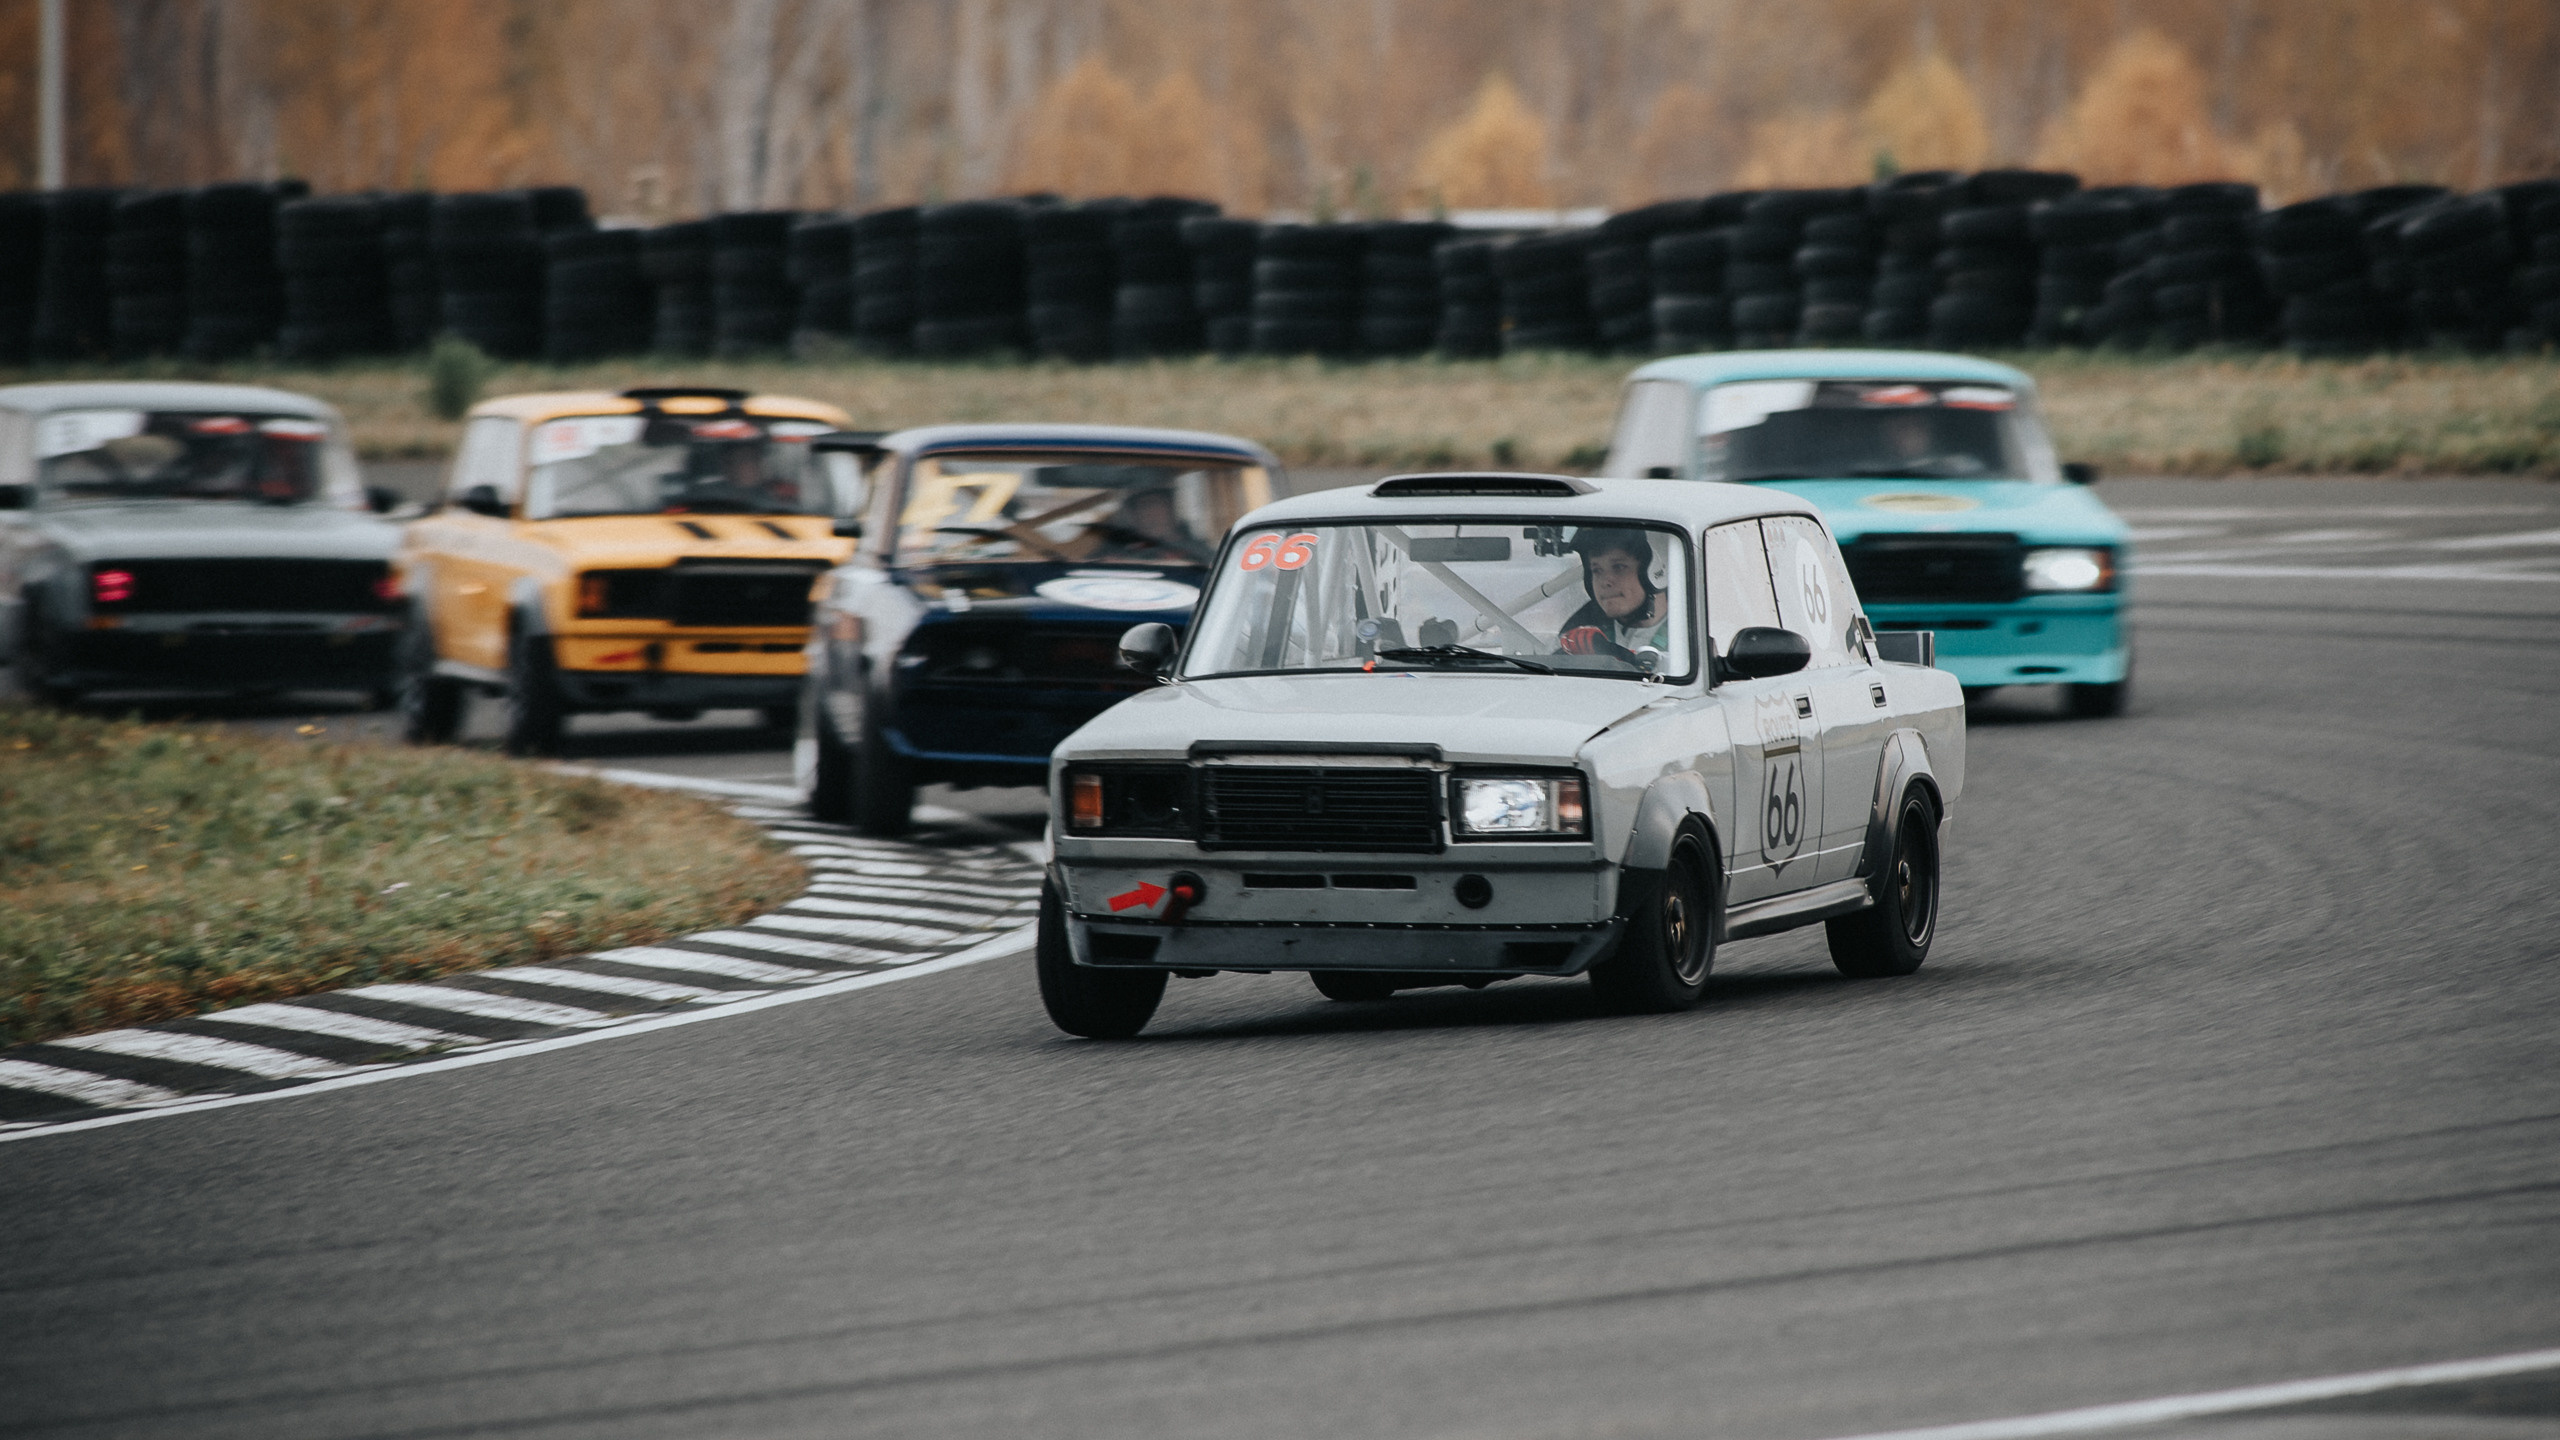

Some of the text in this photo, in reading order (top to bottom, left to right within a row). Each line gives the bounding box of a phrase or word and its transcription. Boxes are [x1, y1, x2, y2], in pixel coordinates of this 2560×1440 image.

[1240, 533, 1320, 572] 66
[1802, 563, 1827, 624] 66
[1763, 715, 1797, 744] ROUTE
[1766, 760, 1800, 850] 66
